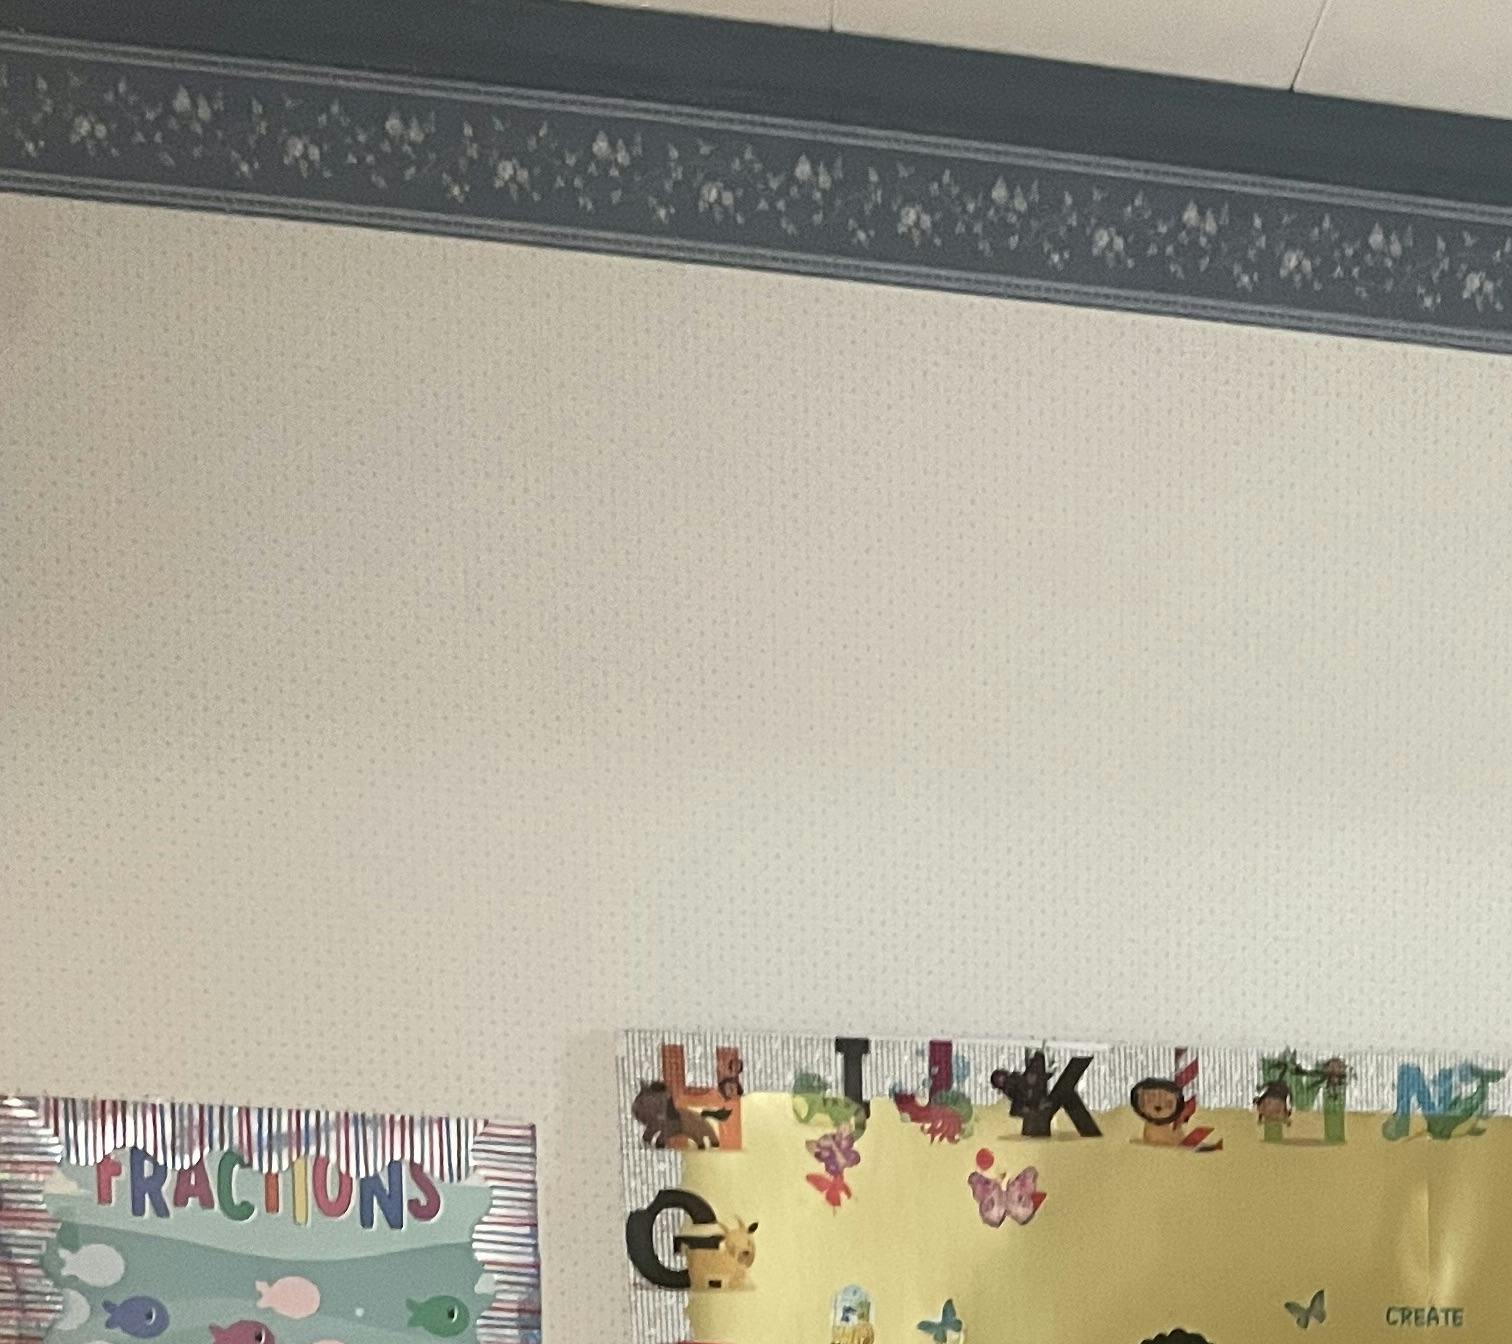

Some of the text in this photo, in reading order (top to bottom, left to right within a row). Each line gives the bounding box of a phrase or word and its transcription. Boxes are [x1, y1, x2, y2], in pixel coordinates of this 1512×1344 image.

[661, 1044, 742, 1149] H
[1020, 1052, 1102, 1137] K
[626, 1189, 726, 1289] G
[1385, 1306, 1464, 1329] CREATE
